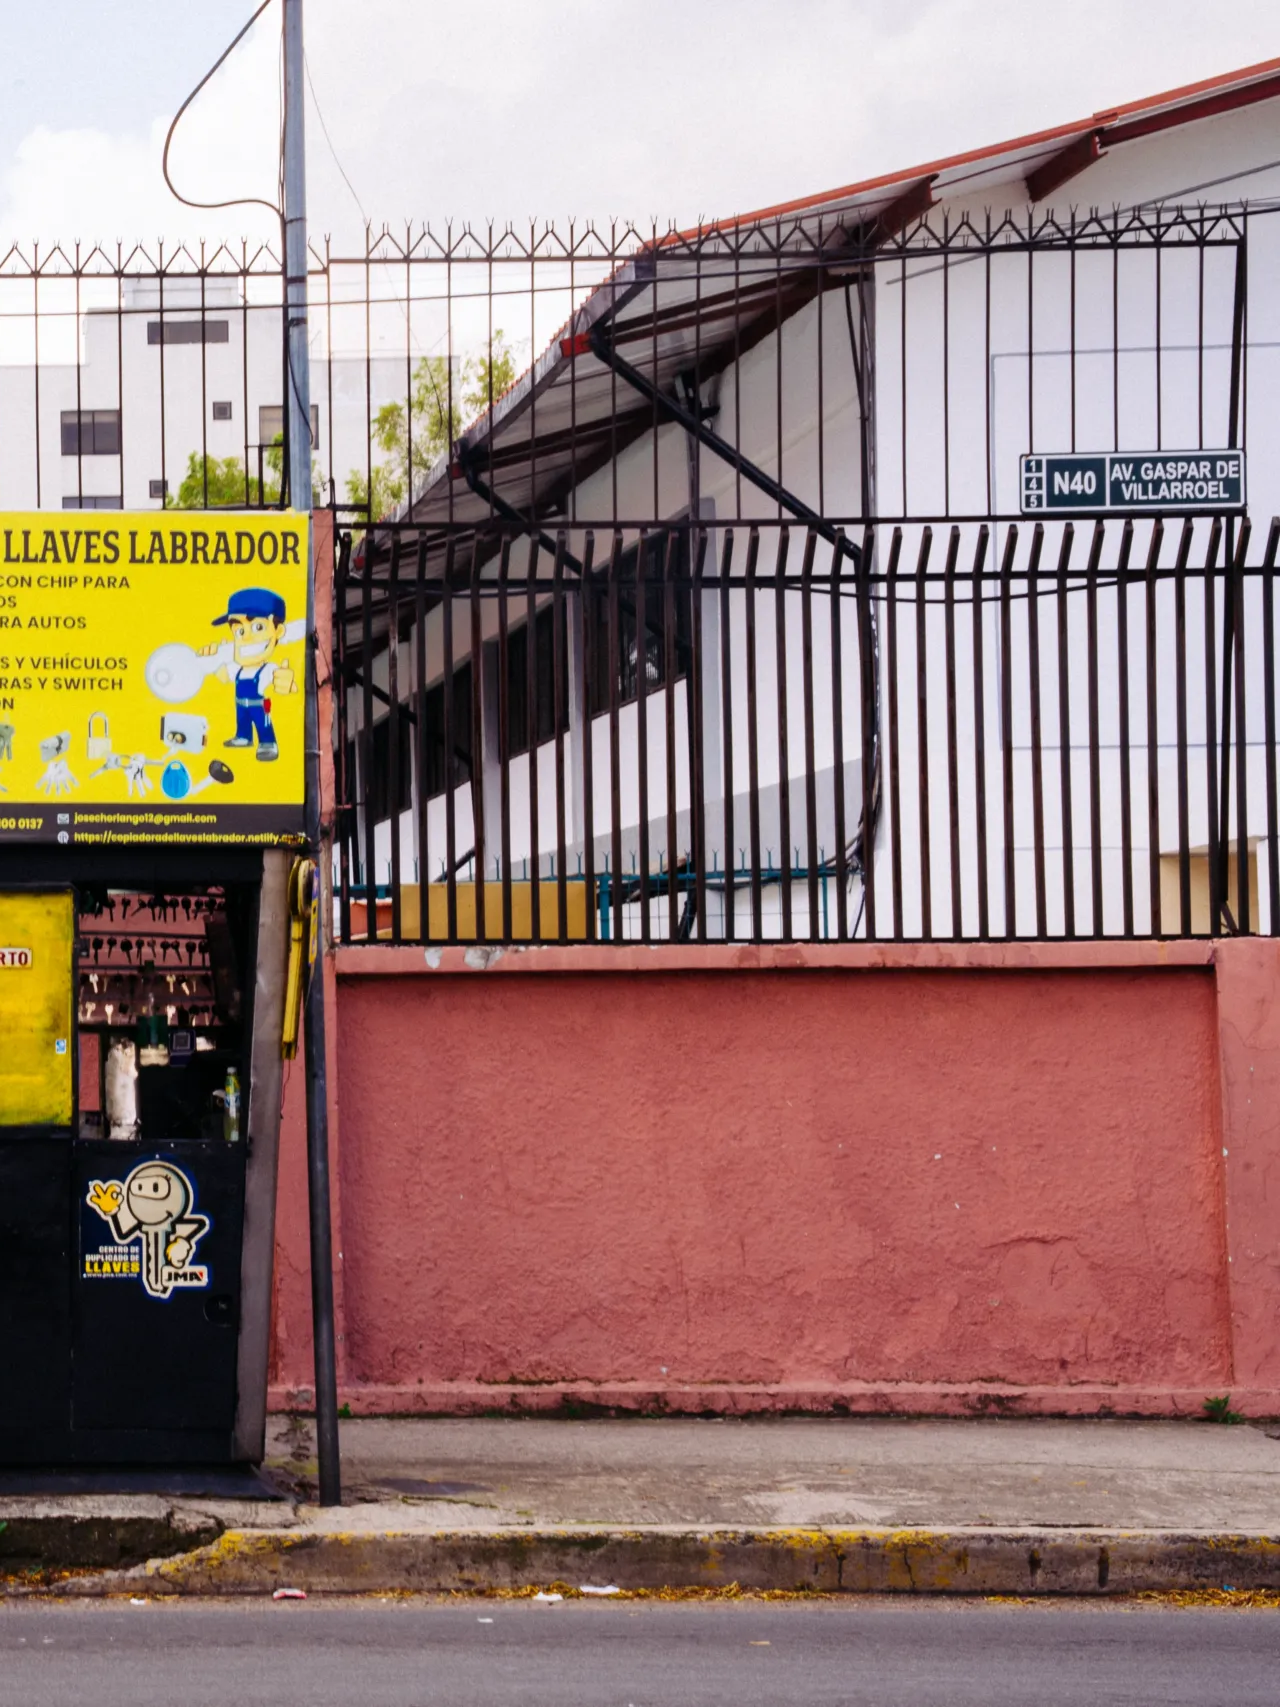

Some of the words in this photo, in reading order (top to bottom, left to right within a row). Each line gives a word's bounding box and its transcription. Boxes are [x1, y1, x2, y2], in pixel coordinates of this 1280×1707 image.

[1028, 461, 1037, 472] 1
[1110, 463, 1136, 482] AV.
[1140, 461, 1212, 480] GASPAR
[1216, 460, 1239, 478] DE
[1028, 479, 1038, 490] 4
[1054, 471, 1097, 495] N40
[1121, 482, 1230, 501] VILLARROEL
[1029, 495, 1038, 507] 5
[3, 529, 120, 564] LLAVES
[128, 530, 300, 565] LABRADOR
[36, 575, 78, 589] CHIP
[83, 576, 131, 589] PARA
[27, 616, 87, 629] AUTOS
[15, 657, 25, 669] Y
[31, 653, 128, 670] VEHÍCULOS
[37, 678, 48, 690] Y
[53, 677, 123, 690] SWITCH
[17, 818, 44, 830] 0137
[98, 1245, 129, 1253] CENTRO
[85, 1254, 129, 1262] DUPLICADO
[130, 1254, 140, 1262] DE
[85, 1261, 140, 1273] LLAVES
[165, 1271, 204, 1282] JMA
